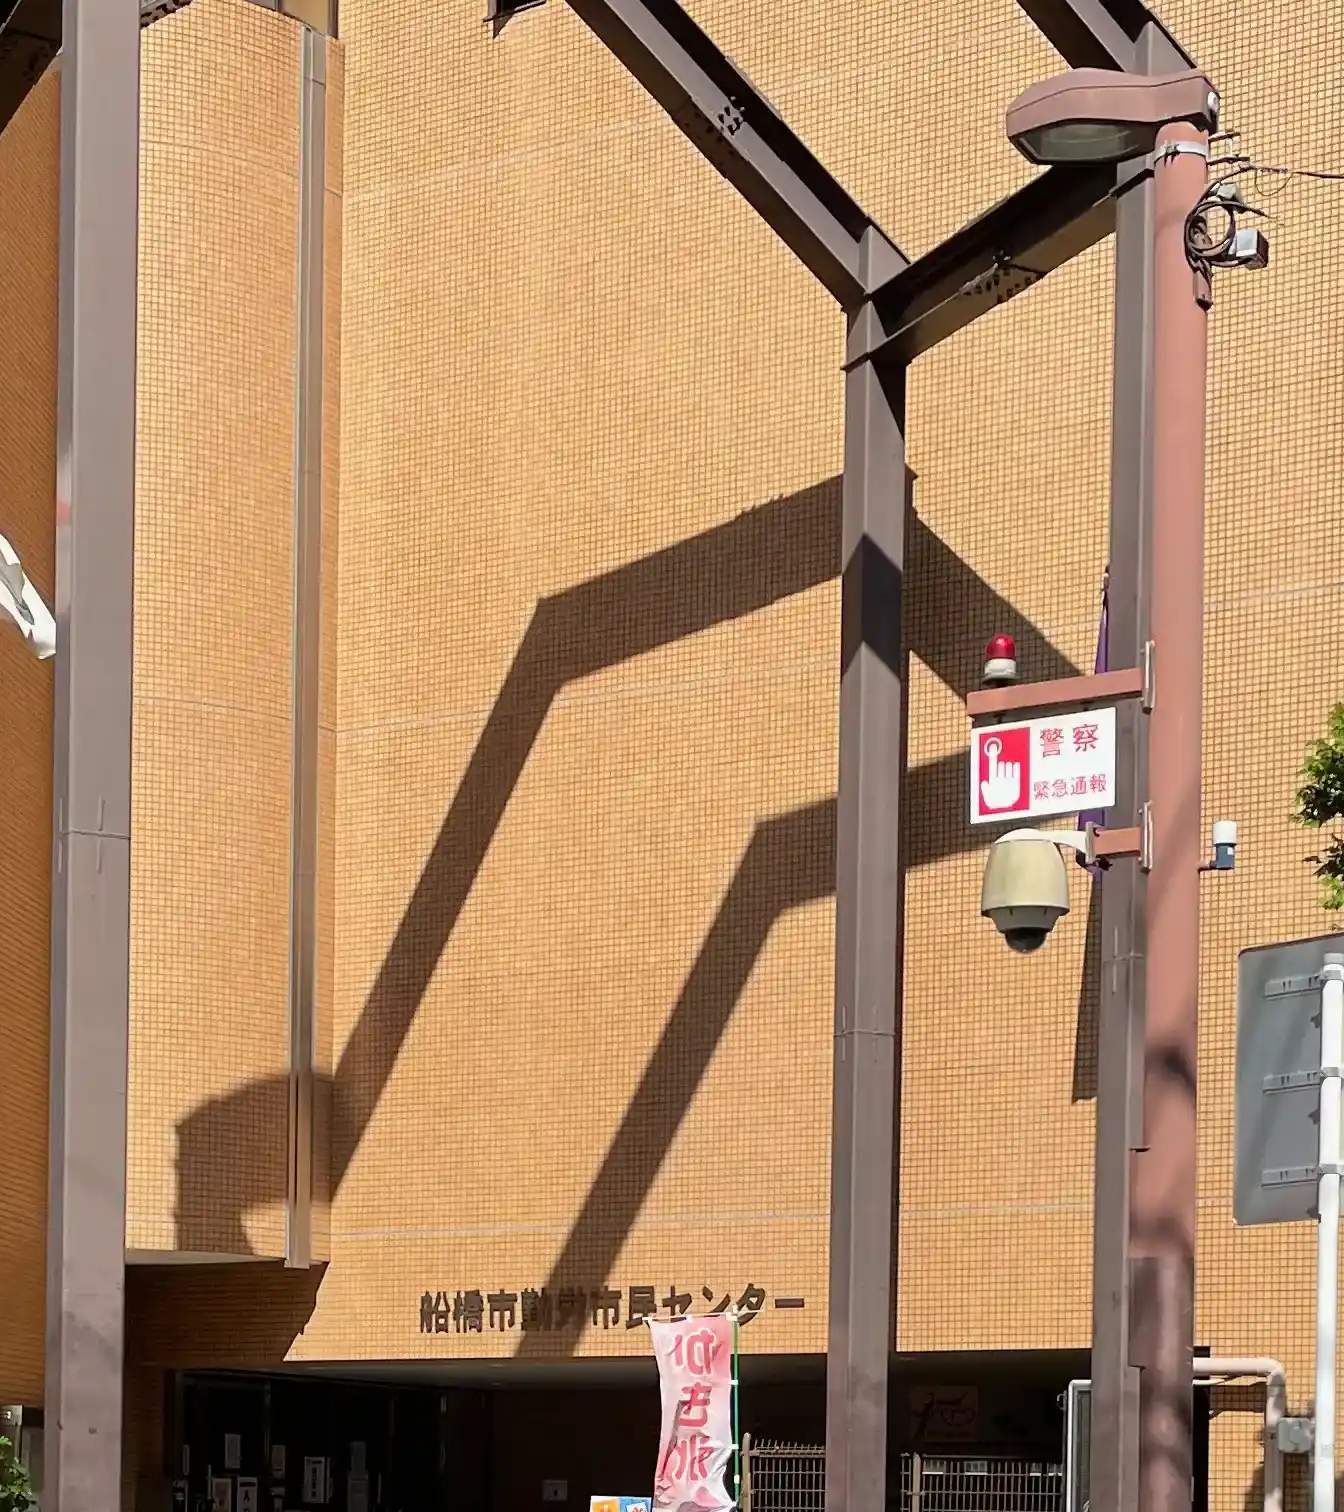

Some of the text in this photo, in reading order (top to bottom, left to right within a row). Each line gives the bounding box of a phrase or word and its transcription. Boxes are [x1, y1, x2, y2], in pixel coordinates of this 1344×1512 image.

[1040, 724, 1099, 758] 警察
[1034, 774, 1107, 801] 緊急通報
